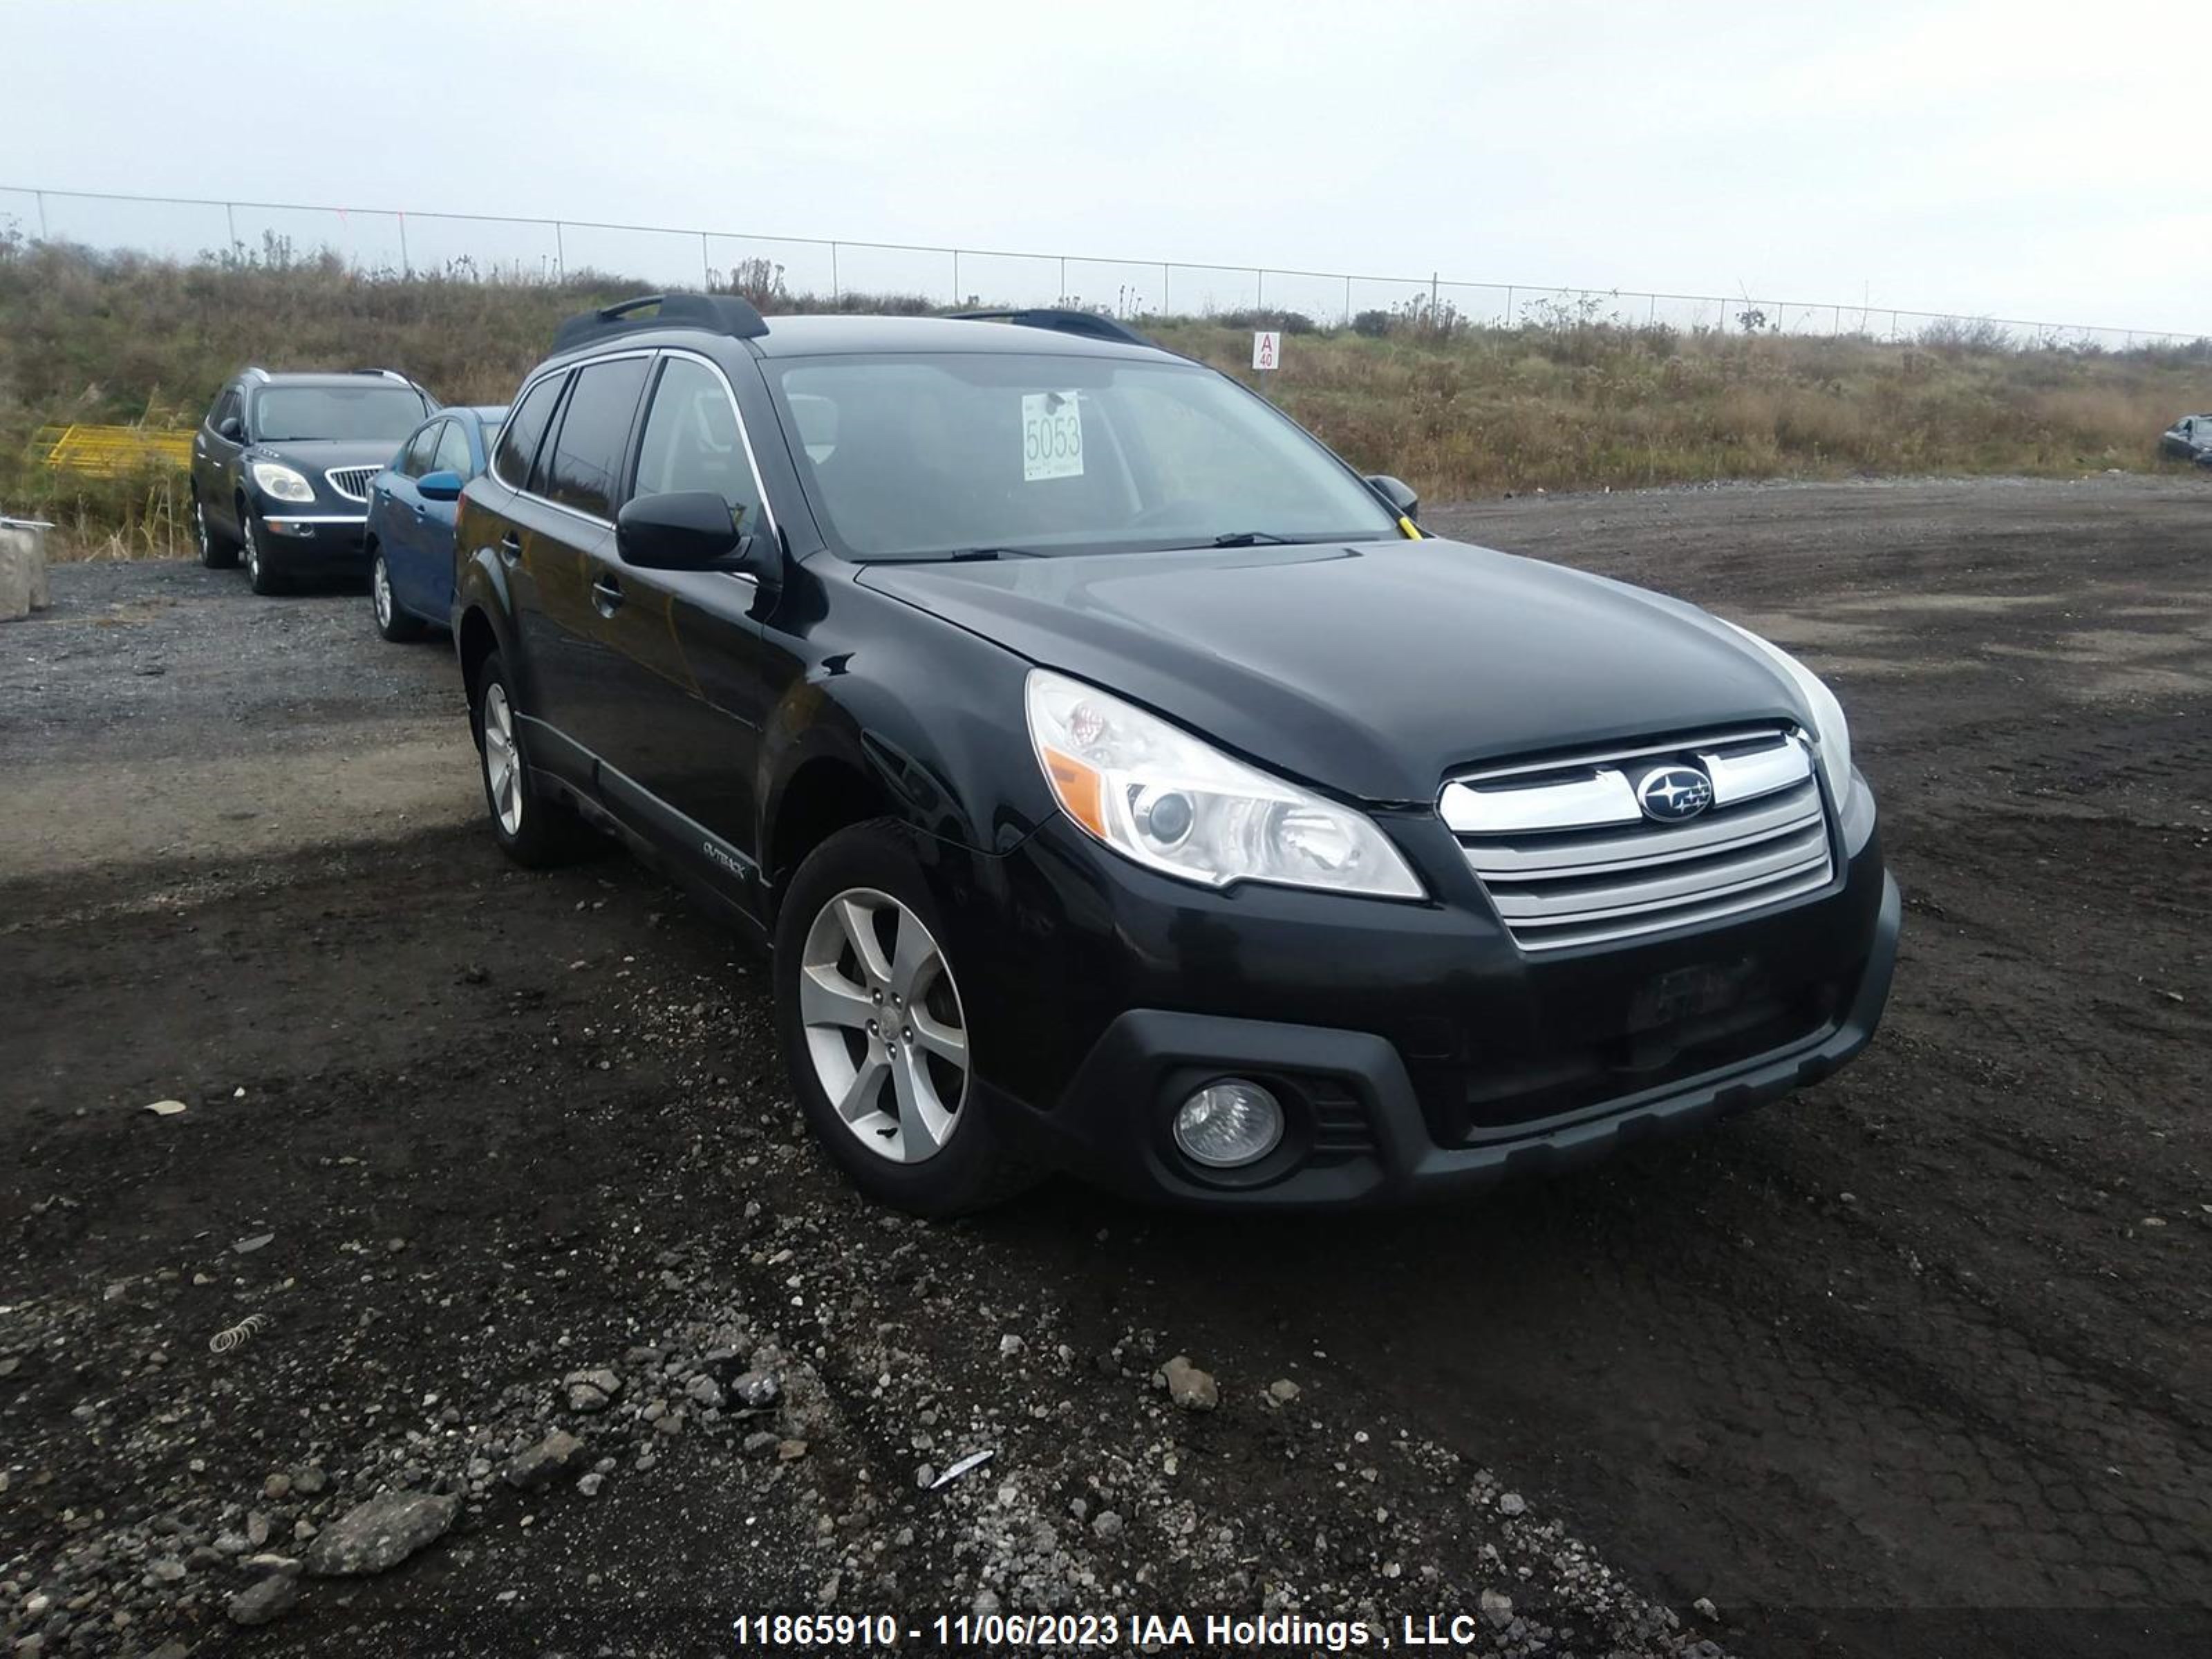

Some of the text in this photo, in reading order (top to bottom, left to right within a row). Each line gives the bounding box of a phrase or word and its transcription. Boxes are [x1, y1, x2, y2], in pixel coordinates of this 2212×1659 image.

[1262, 334, 1272, 352] A
[1260, 353, 1272, 366] 40
[1027, 415, 1080, 460] 5053
